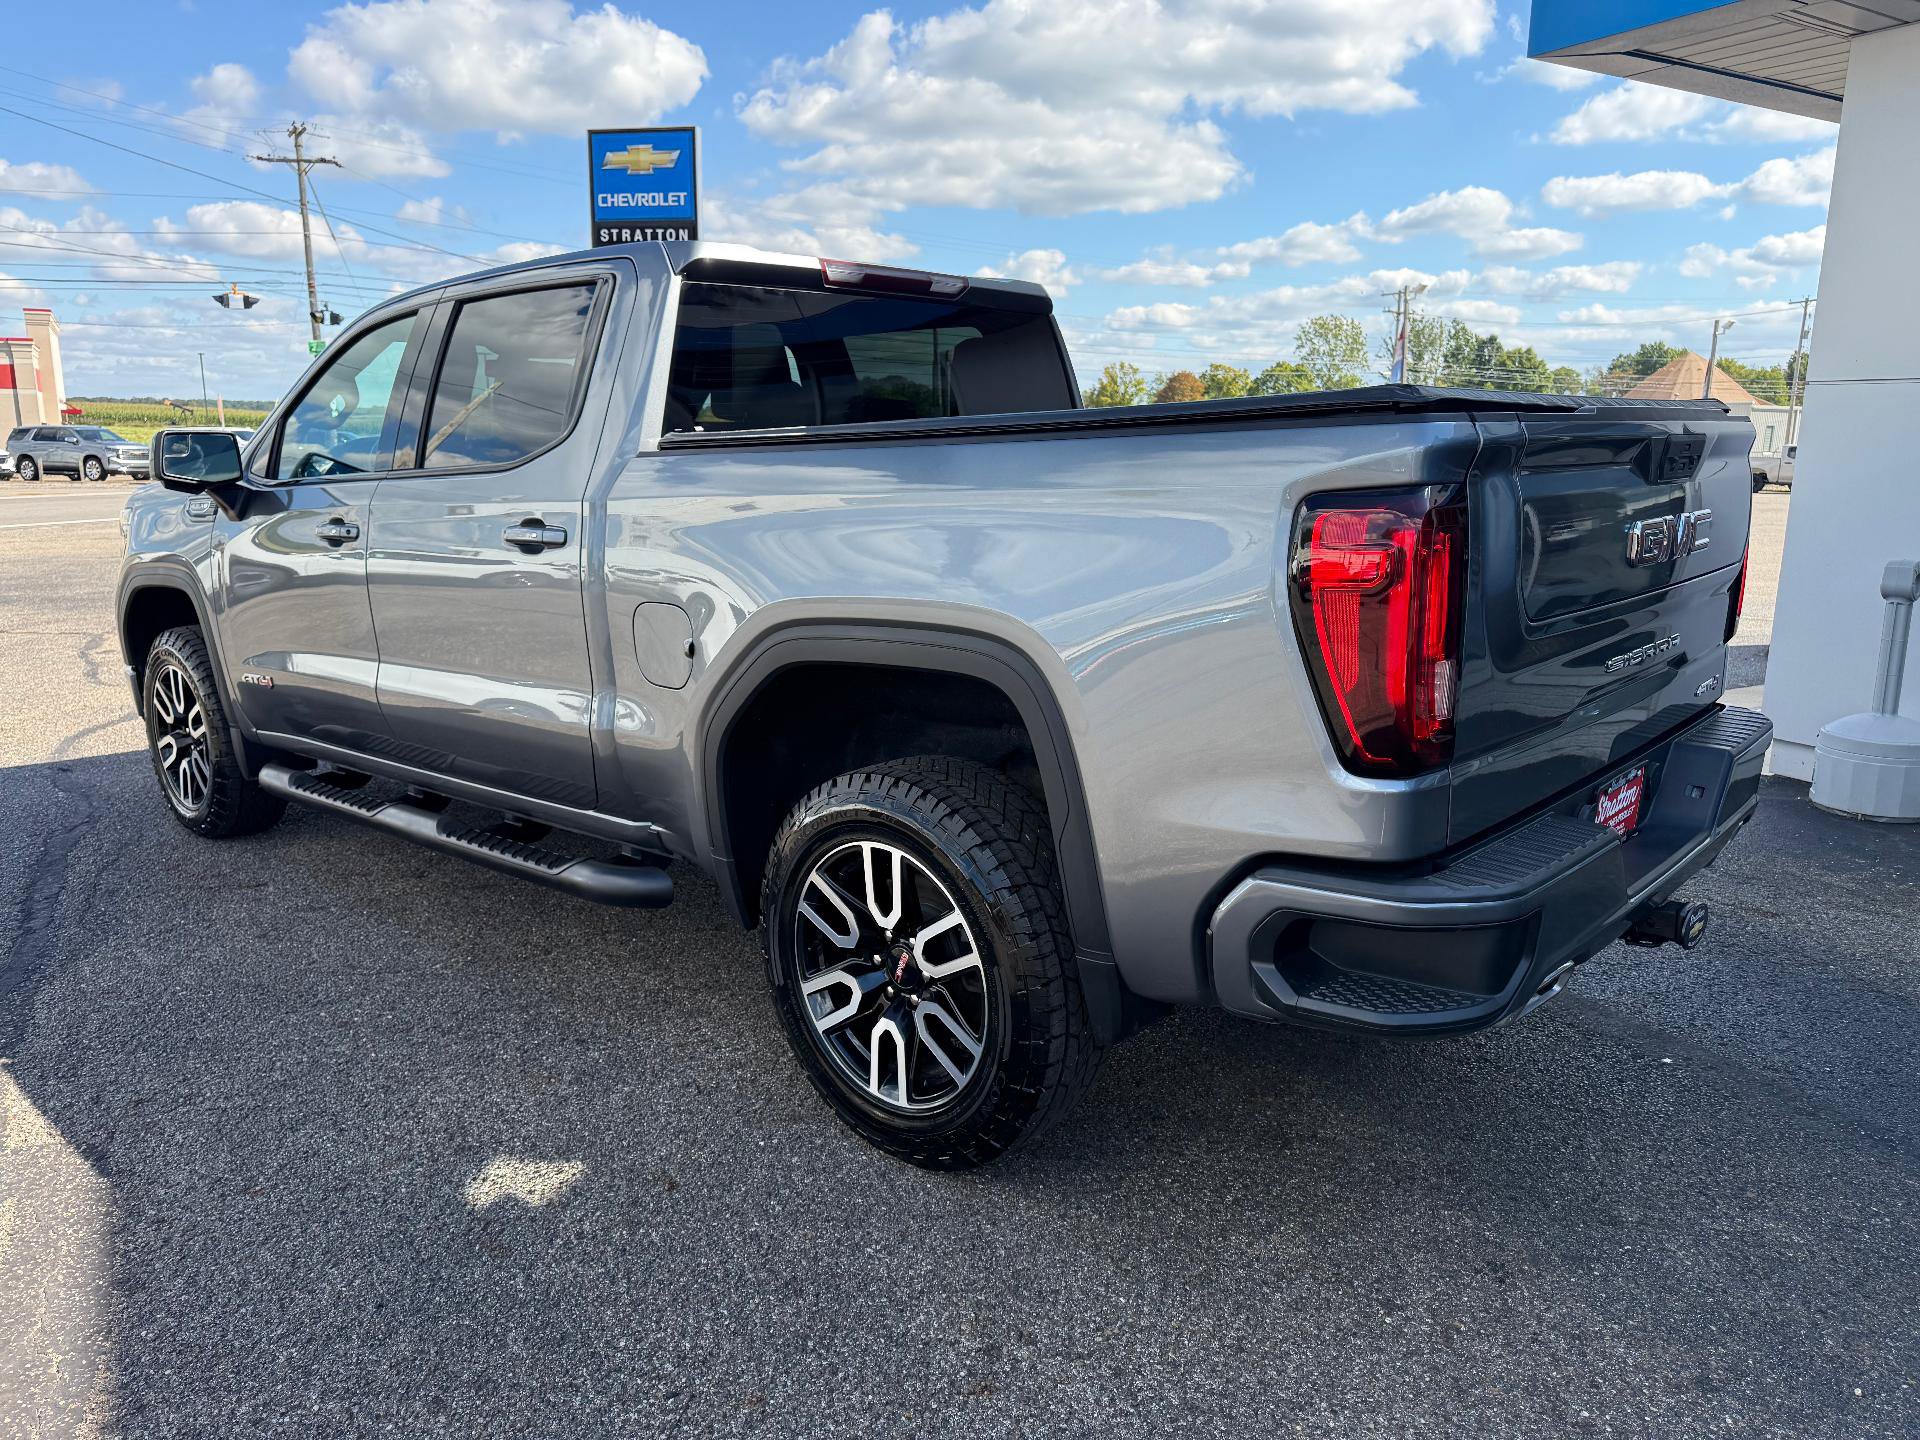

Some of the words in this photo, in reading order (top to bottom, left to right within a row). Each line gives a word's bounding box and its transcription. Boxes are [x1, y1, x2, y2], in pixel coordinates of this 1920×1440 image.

[597, 192, 688, 207] CHEVROLET
[600, 228, 689, 242] STRATTON
[1626, 508, 1712, 568] GMC
[1604, 633, 1681, 673] SIERRA
[241, 673, 273, 688] AT4
